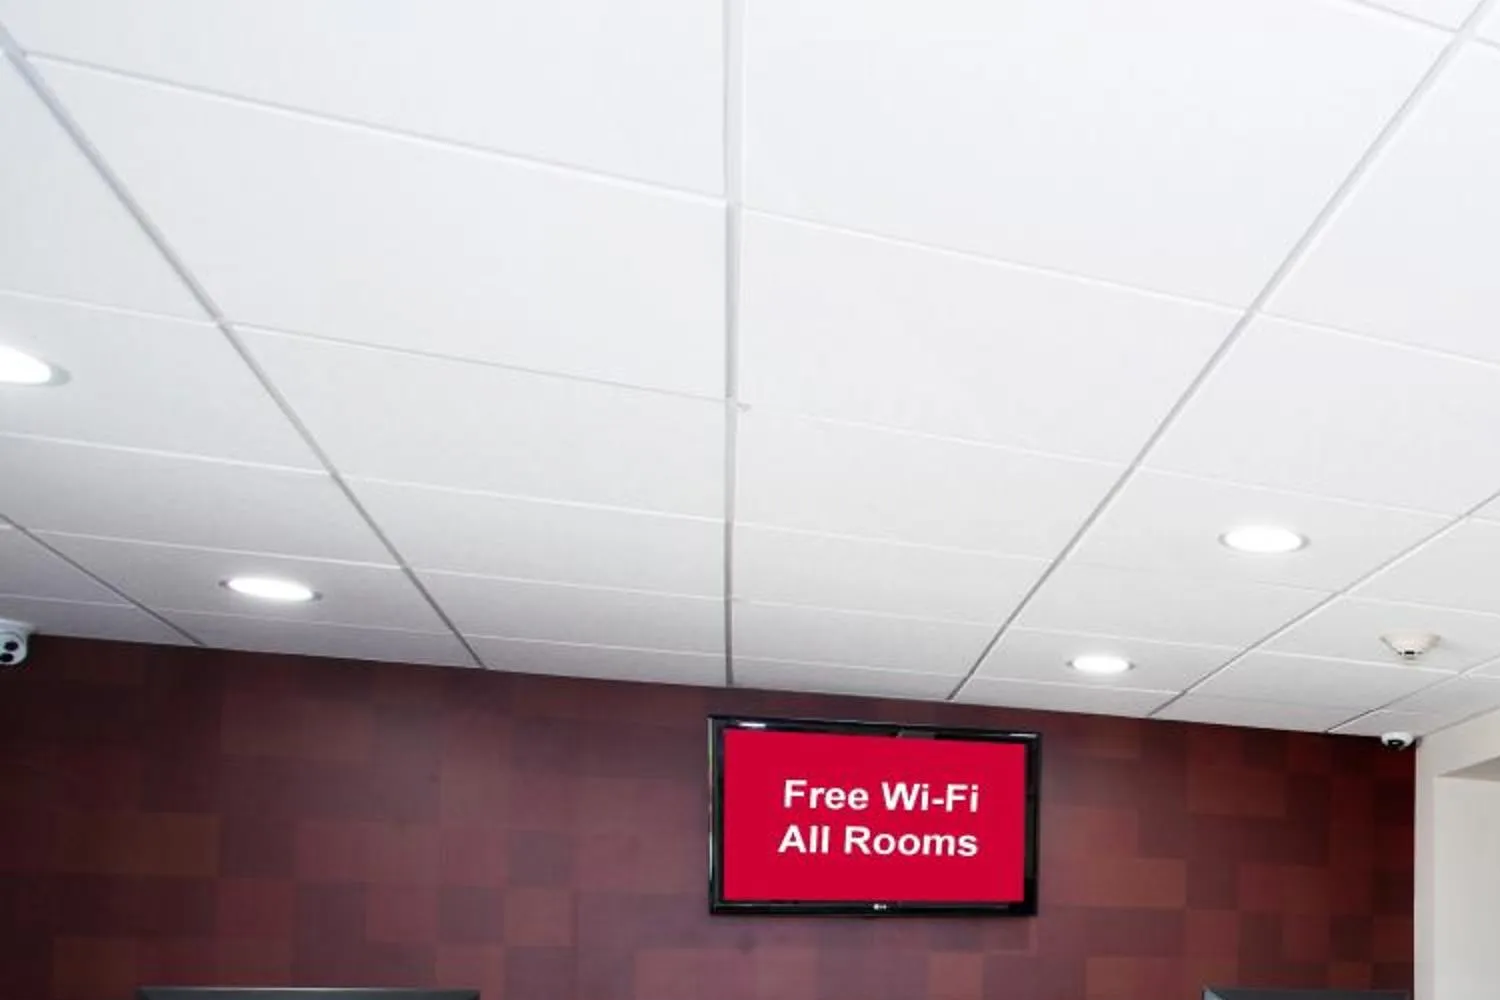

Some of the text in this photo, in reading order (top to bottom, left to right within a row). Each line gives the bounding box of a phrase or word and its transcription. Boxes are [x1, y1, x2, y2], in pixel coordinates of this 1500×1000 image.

[784, 779, 979, 813] Free Wi-Fi
[777, 824, 979, 857] All Rooms
